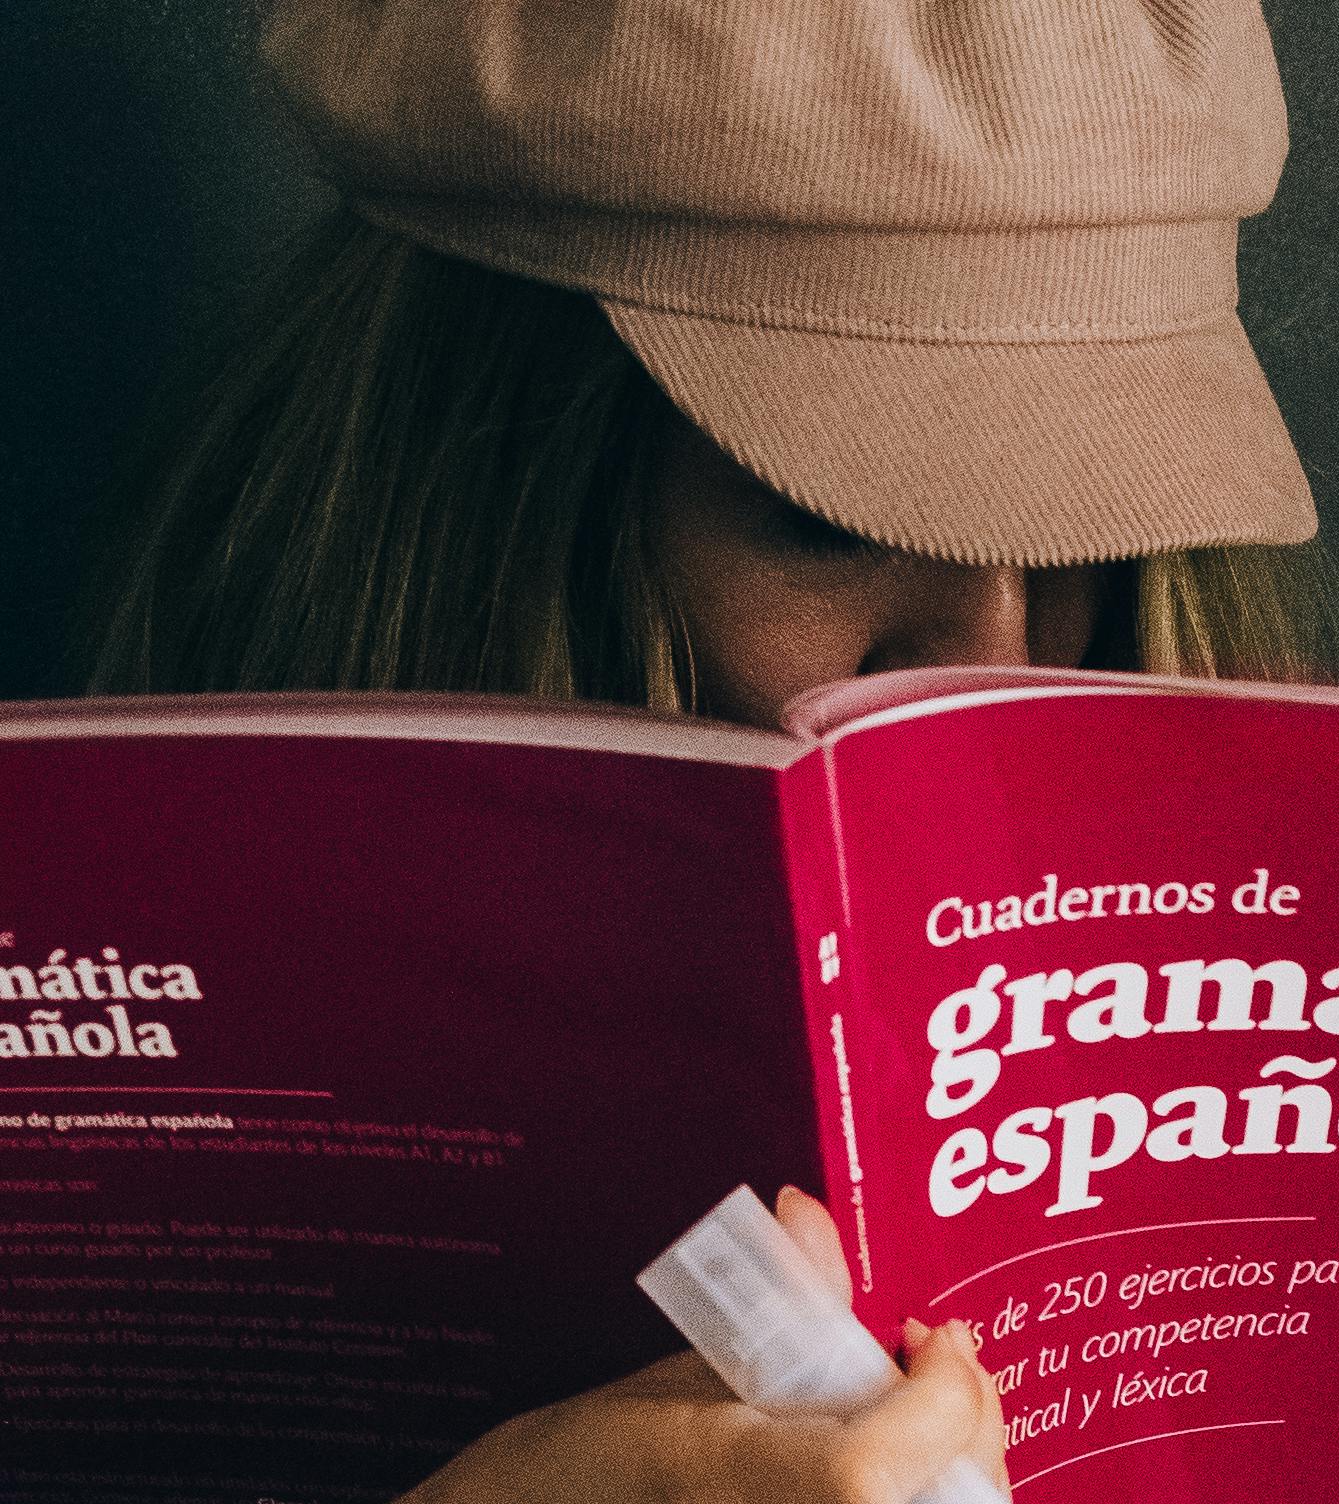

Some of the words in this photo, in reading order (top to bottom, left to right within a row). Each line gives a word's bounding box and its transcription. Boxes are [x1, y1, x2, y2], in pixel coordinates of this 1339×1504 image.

[926, 873, 1216, 947] Cuadernos
[1231, 868, 1301, 916] de
[27, 1111, 51, 1128] de
[54, 1111, 148, 1132] gramática
[151, 1111, 235, 1132] española
[992, 1297, 1029, 1340] de
[1037, 1271, 1108, 1322] 250
[1118, 1253, 1277, 1310] ejercicios
[1038, 1345, 1070, 1378] tu
[1081, 1303, 1310, 1360] competencia
[1078, 1390, 1103, 1430] y
[1111, 1366, 1209, 1408] léxica
